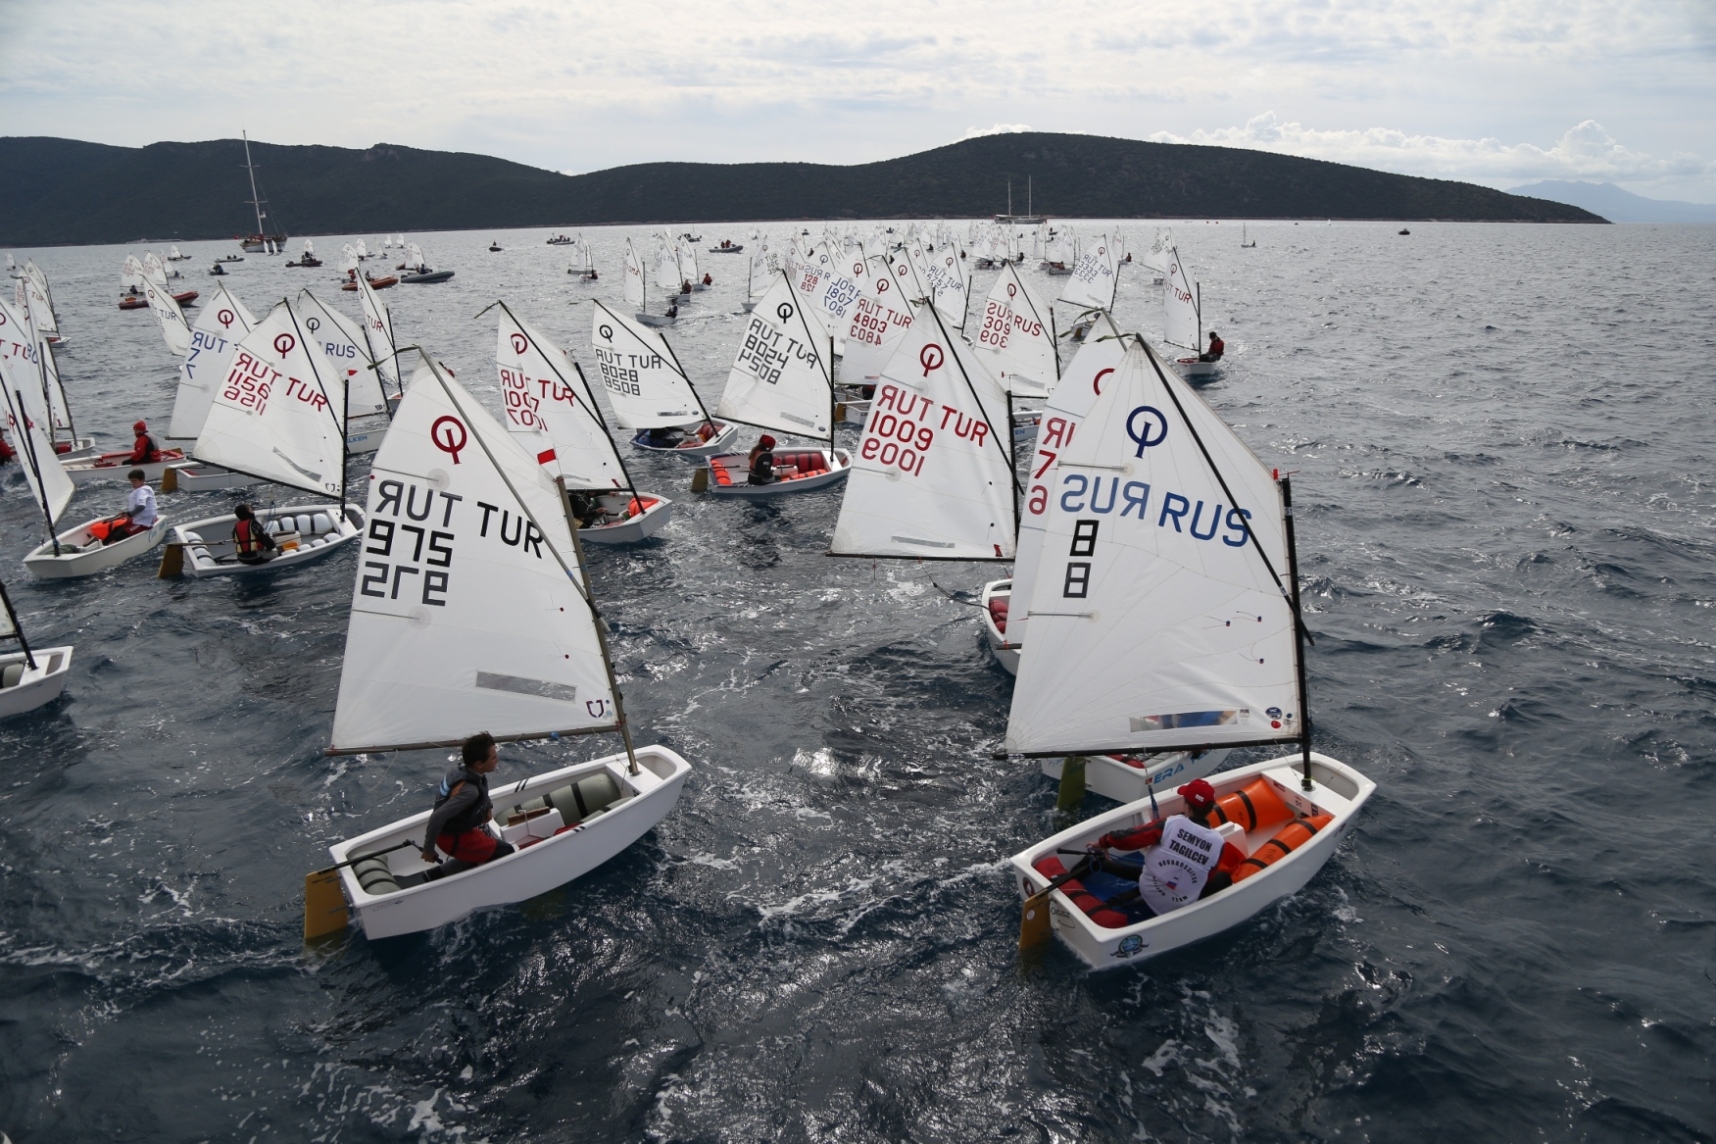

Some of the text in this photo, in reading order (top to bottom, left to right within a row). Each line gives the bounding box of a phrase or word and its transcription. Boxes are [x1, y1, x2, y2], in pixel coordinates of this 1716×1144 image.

[804, 274, 819, 285] 128
[1079, 261, 1098, 277] 3333
[1098, 264, 1112, 277] TUR
[947, 277, 962, 292] TUR
[826, 285, 853, 306] 1807
[1175, 288, 1191, 304] TUR
[160, 310, 177, 321] TUR
[367, 315, 384, 332] TUR
[854, 313, 887, 333] 4803
[887, 309, 912, 329] TUR
[984, 316, 1011, 335] 309
[1014, 315, 1042, 336] RUS
[188, 348, 200, 362] 7
[325, 343, 355, 358] RUS
[745, 334, 789, 369] 8024
[787, 338, 817, 369] TUR
[600, 362, 638, 382] 8028
[628, 355, 662, 369] TUR
[228, 369, 271, 399] 1156
[285, 377, 328, 412] TUR
[538, 379, 574, 407] TUR
[504, 389, 539, 412] 1007
[869, 410, 933, 451] 1009
[940, 405, 988, 447] TUR
[1158, 491, 1252, 547] RUS
[477, 501, 544, 559] TUR
[1069, 519, 1099, 557] 8
[366, 518, 454, 568] 975
[1154, 762, 1184, 784] ERA
[1177, 828, 1212, 852] SEMYON
[1169, 840, 1209, 865] TAGILCEV
